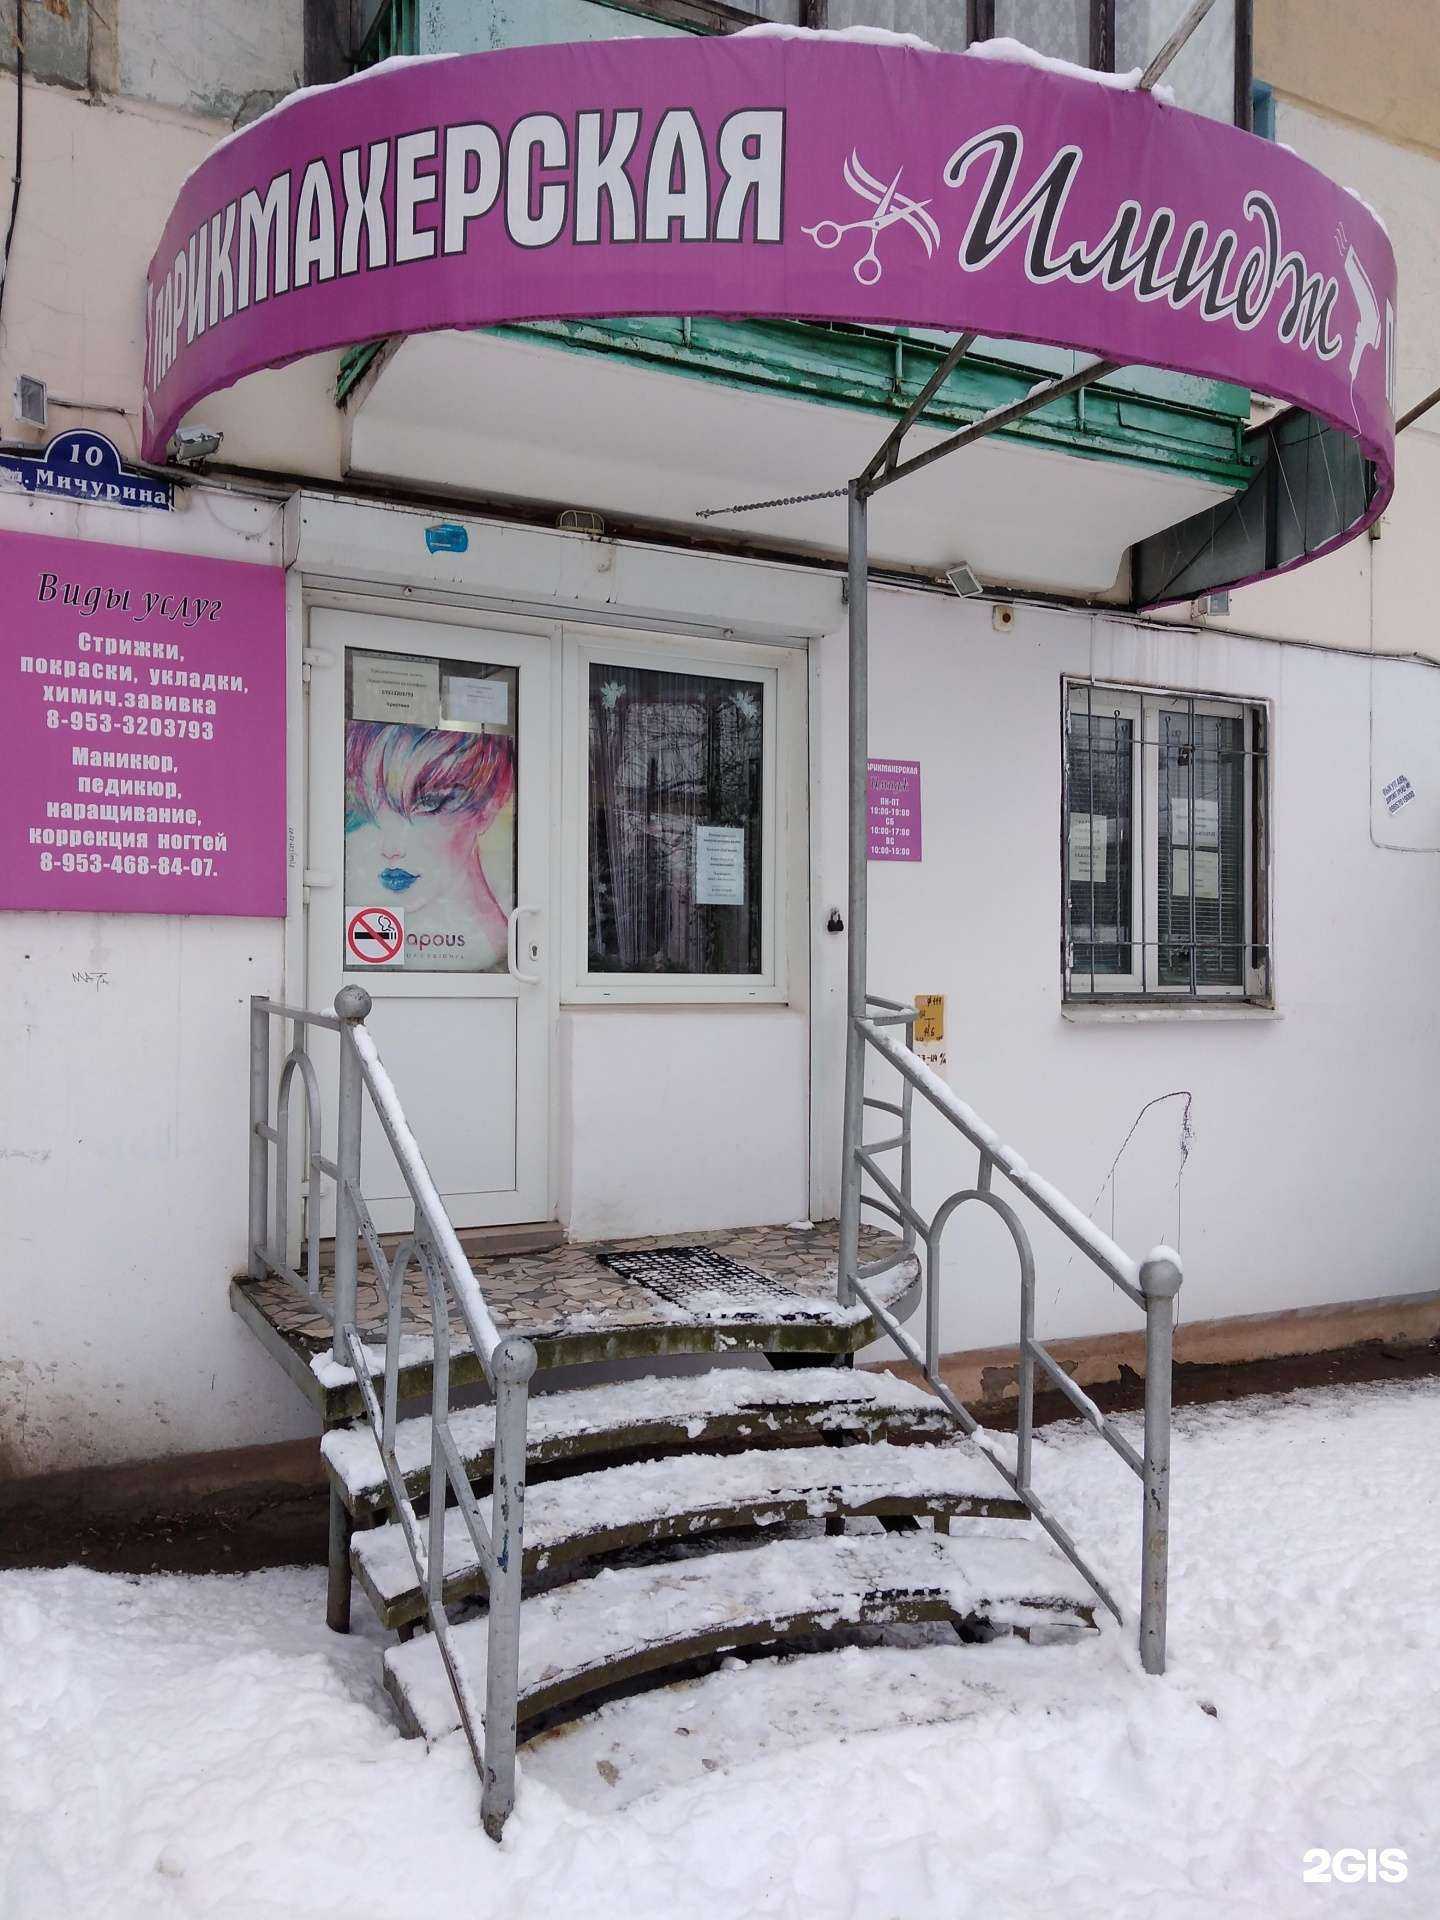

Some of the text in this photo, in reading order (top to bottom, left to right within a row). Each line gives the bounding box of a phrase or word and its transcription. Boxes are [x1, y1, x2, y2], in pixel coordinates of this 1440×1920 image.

[152, 107, 786, 393] ПАРИКМАХЕРСКАЯ
[943, 124, 1343, 362] Имидж
[70, 443, 103, 467] 10
[36, 468, 168, 505] Мичурина
[38, 572, 224, 628] Виды услуг
[78, 632, 185, 662] Стрижки,
[20, 656, 249, 694] покраски, укладки,
[43, 685, 217, 715] химич.завивка
[46, 709, 214, 741] 8-953-3203793
[71, 746, 179, 774] Маникюр,
[78, 776, 183, 800] педикюр,
[46, 801, 203, 827] наращивание,
[29, 827, 228, 852] коррекция ногтей
[40, 852, 219, 877] 8-953-468-84-07.
[406, 933, 466, 951] apous
